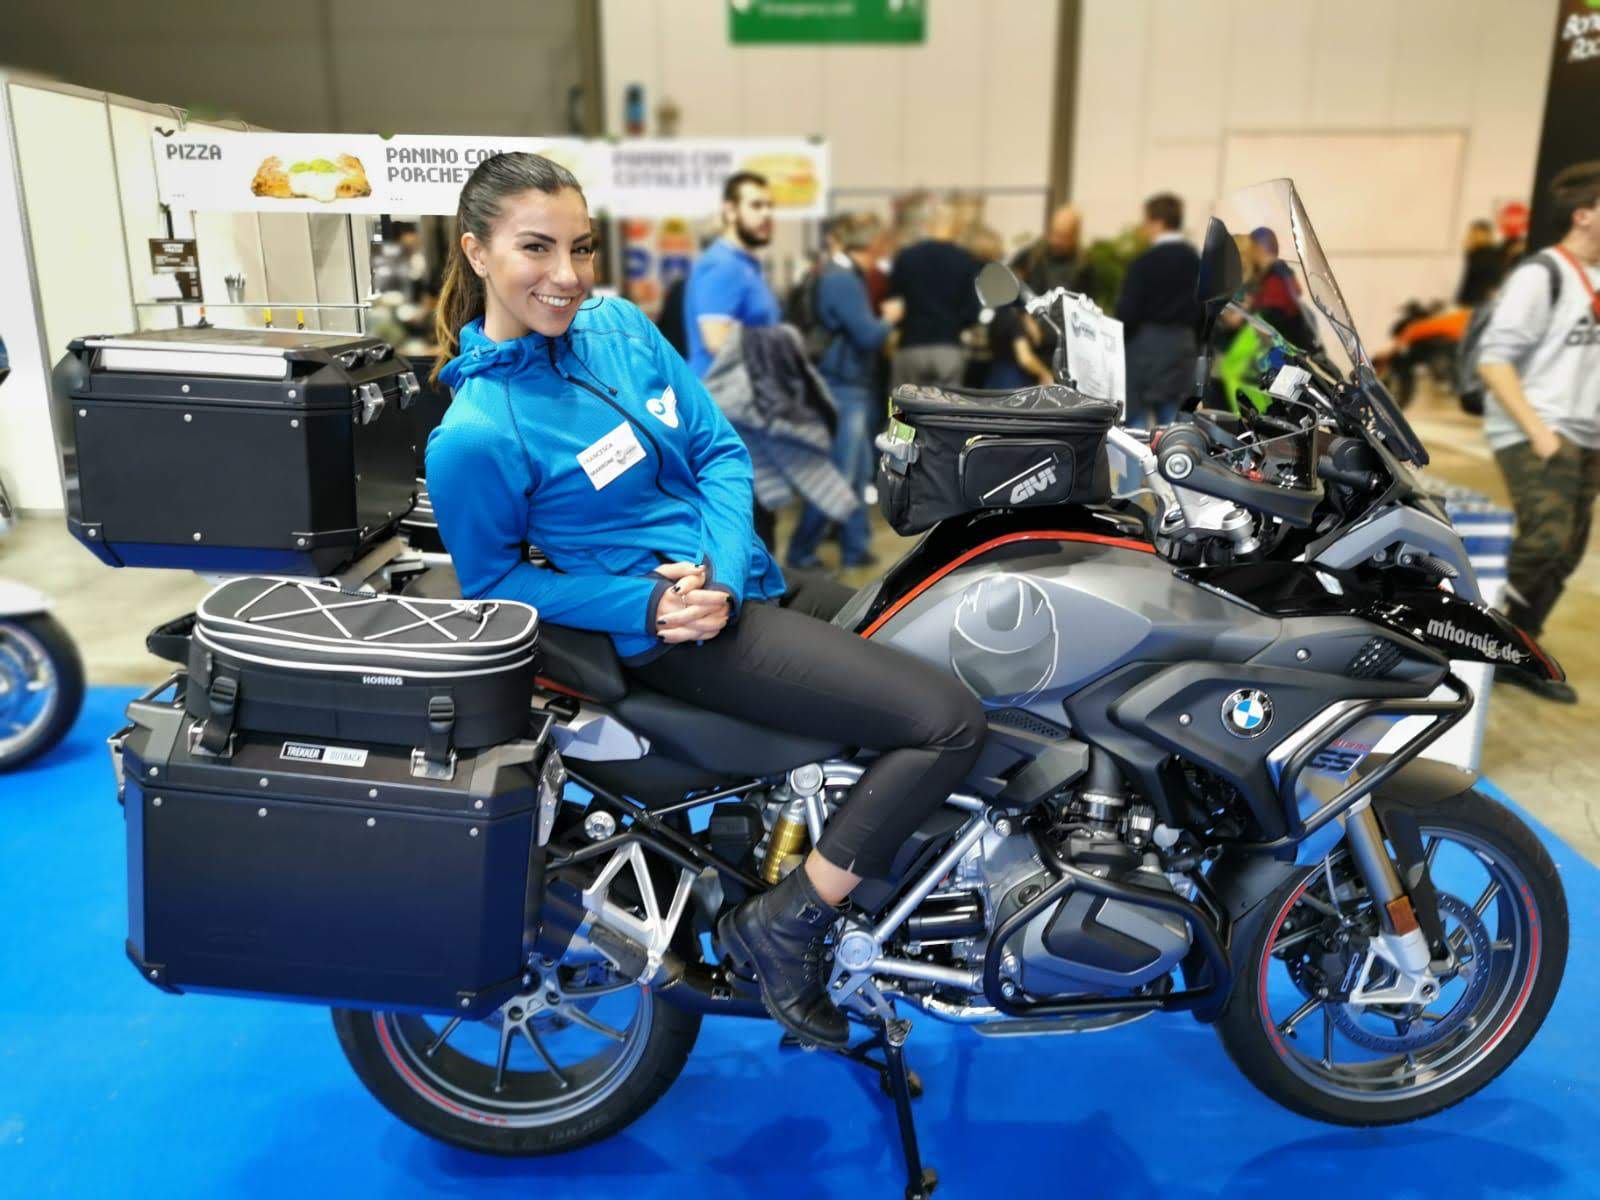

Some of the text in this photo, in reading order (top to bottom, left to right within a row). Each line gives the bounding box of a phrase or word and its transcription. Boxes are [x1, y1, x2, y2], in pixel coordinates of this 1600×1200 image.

[166, 144, 222, 160] PIZZA
[385, 147, 458, 164] PANINO
[387, 166, 478, 184] PORCHET
[1010, 466, 1057, 504] GIVI
[1426, 618, 1521, 664] mhornig.de
[362, 675, 403, 686] HORNIG
[286, 745, 321, 760] TREKKER
